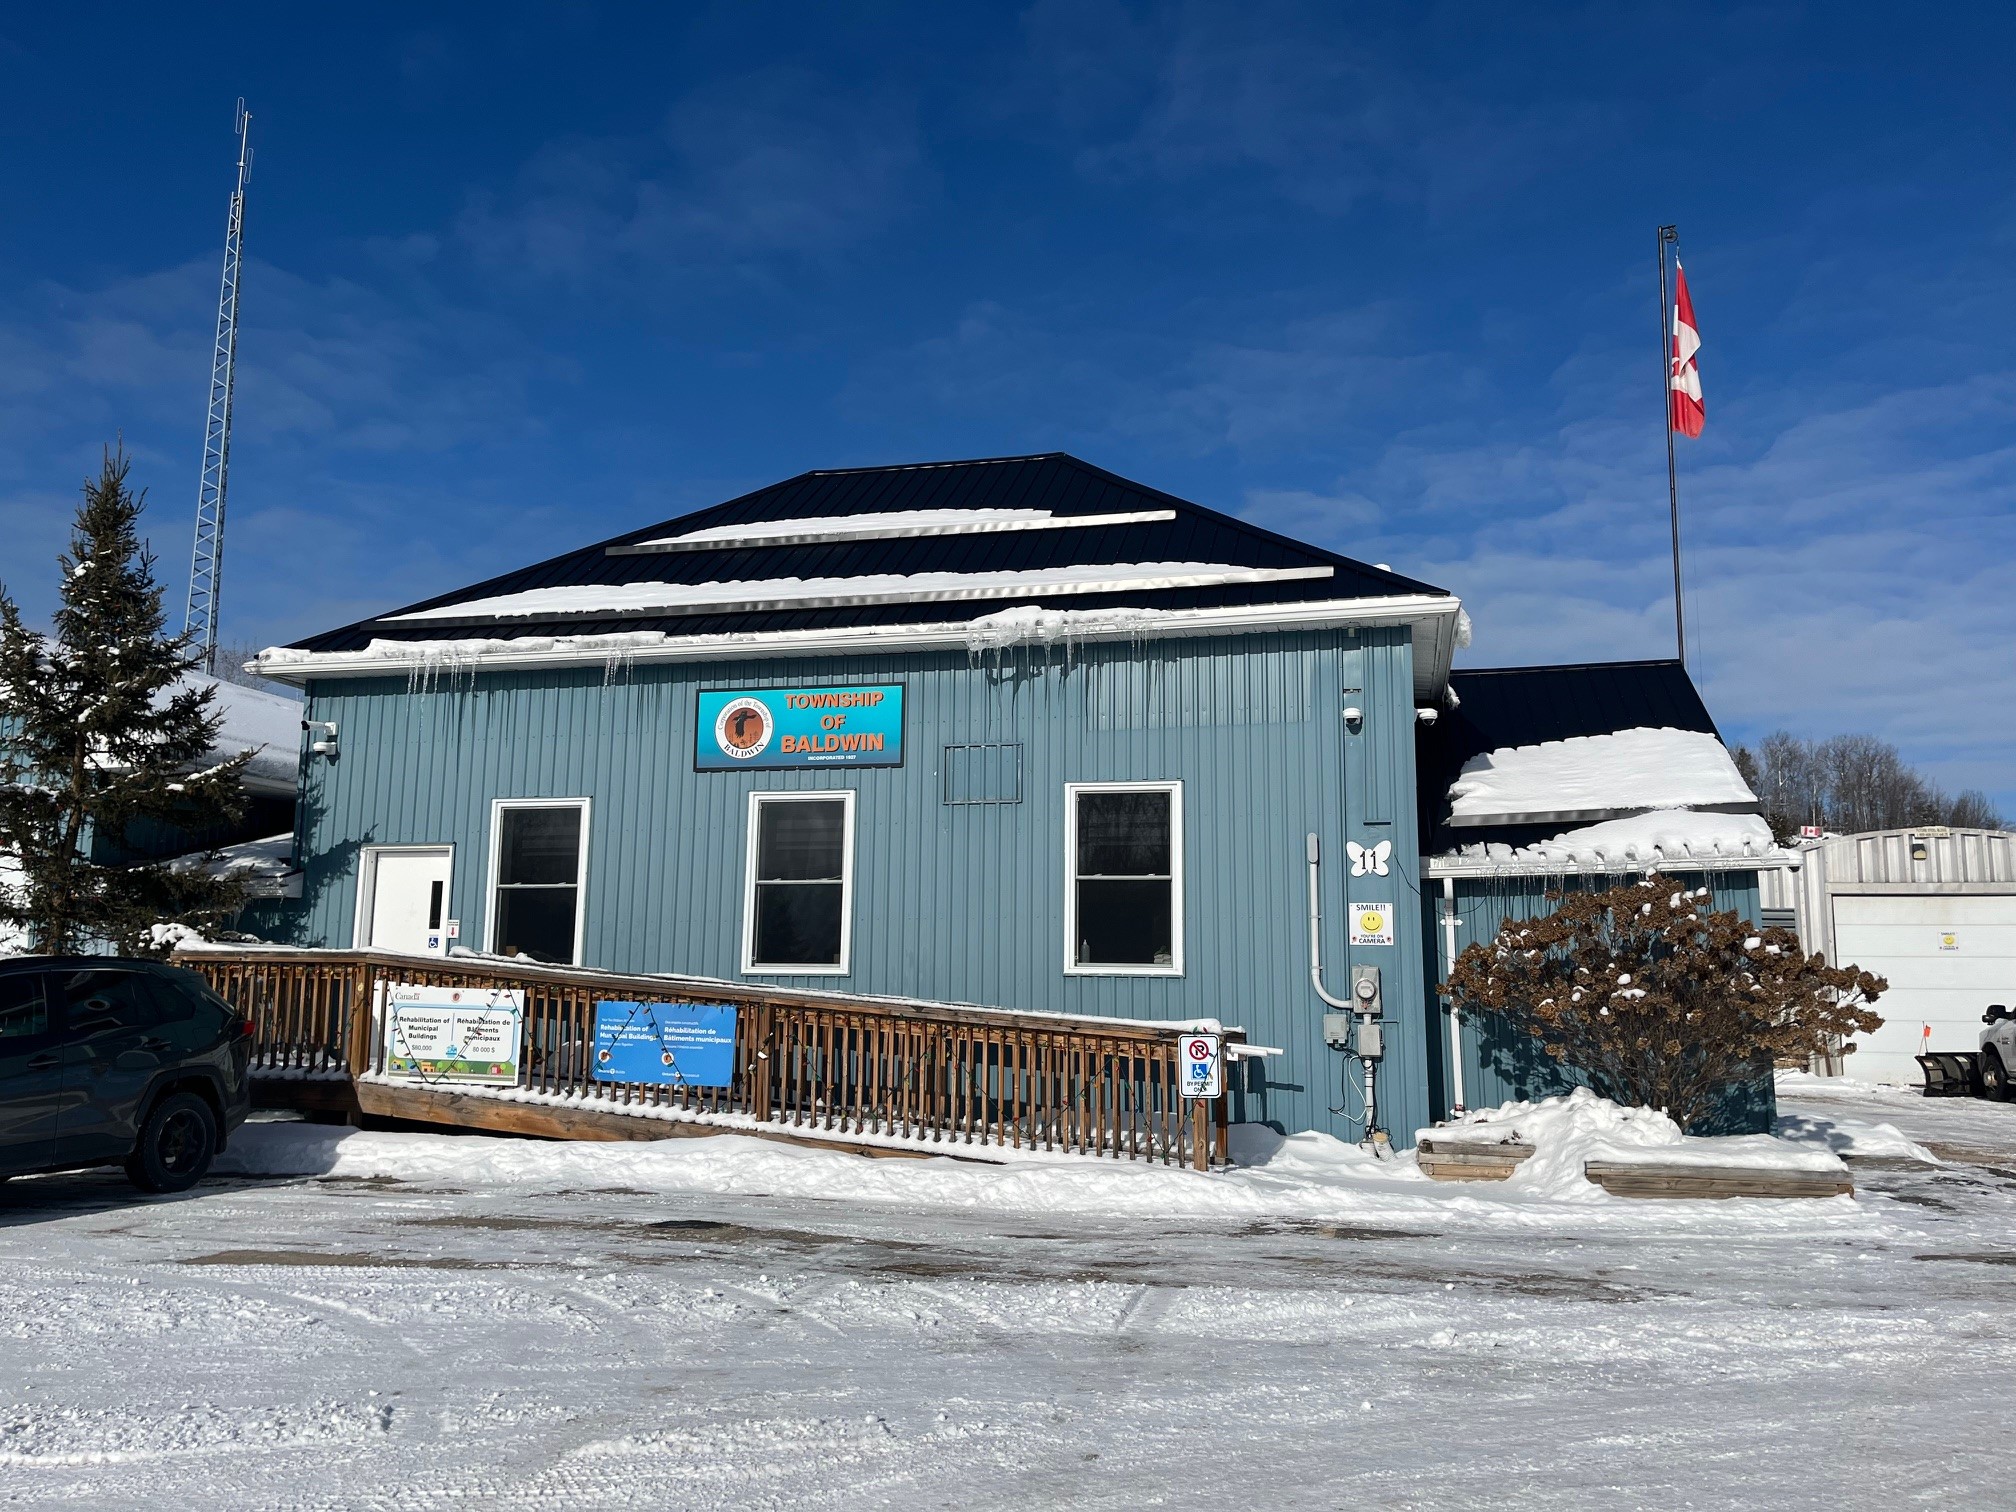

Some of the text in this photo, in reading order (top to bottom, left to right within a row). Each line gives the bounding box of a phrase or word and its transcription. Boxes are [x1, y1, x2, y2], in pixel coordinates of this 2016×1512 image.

[785, 691, 884, 710] TOWNSHIP
[821, 714, 847, 731] OF
[724, 742, 764, 758] BALDWIN
[781, 733, 884, 754] BALDWIN
[1360, 851, 1377, 870] 11
[663, 1034, 695, 1042] Bâtiments
